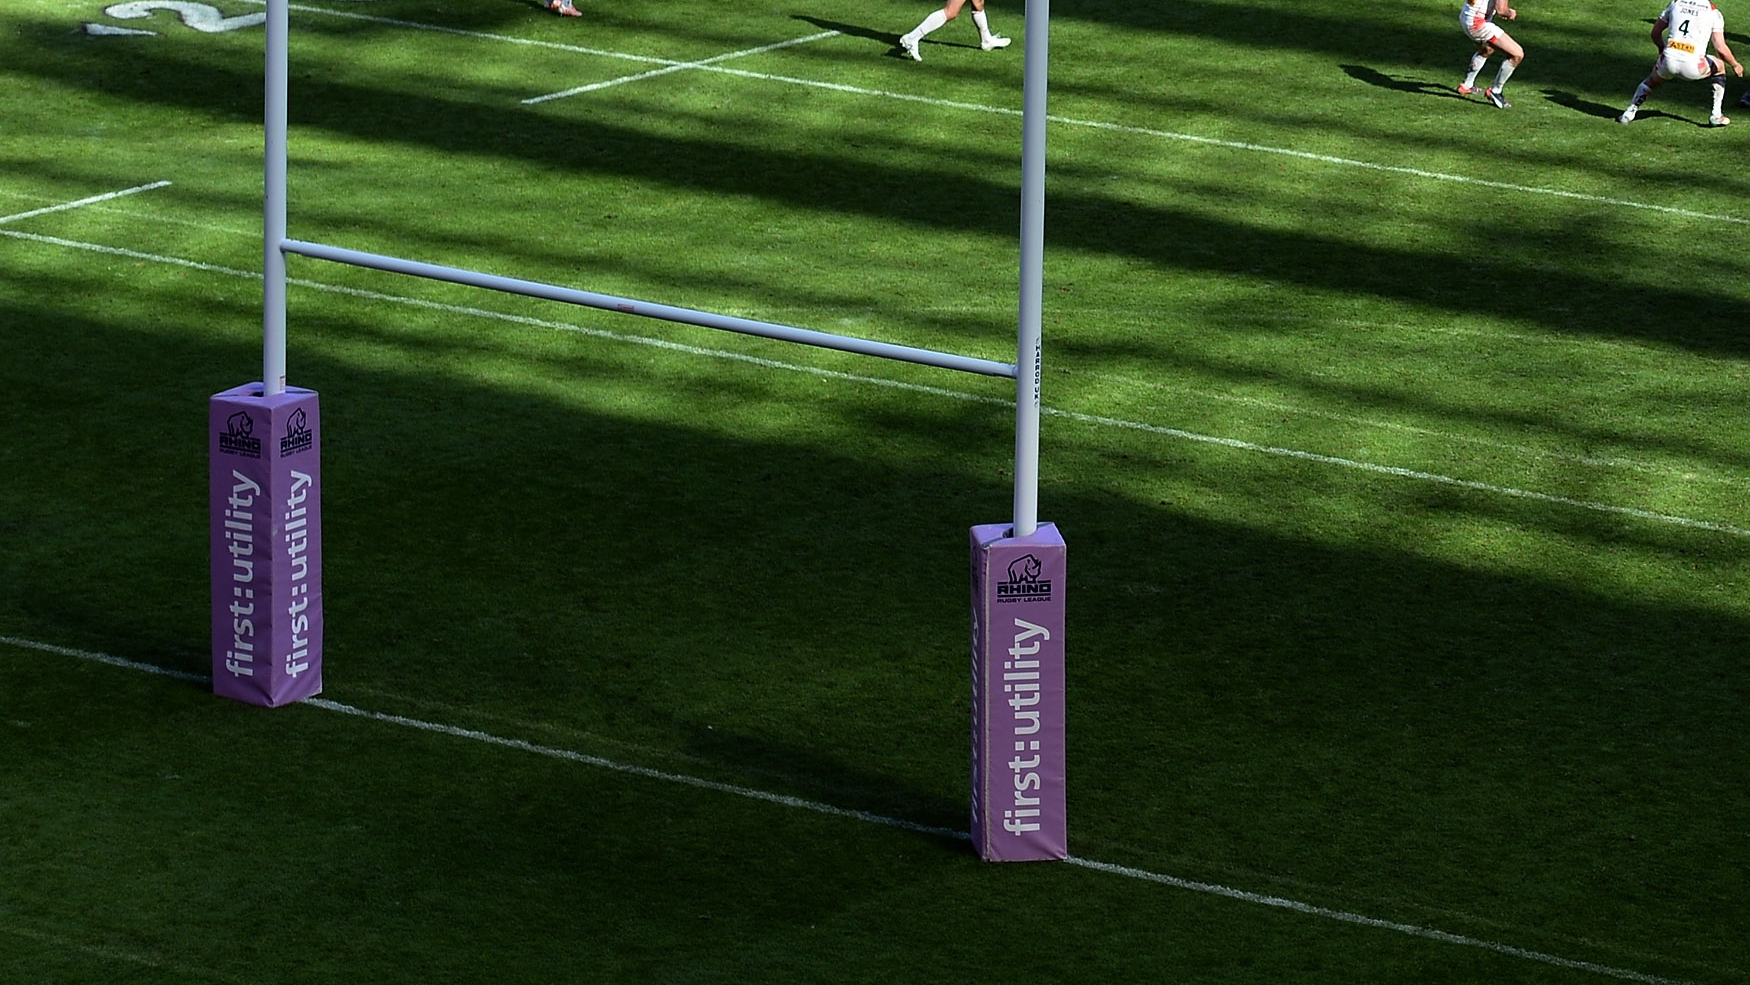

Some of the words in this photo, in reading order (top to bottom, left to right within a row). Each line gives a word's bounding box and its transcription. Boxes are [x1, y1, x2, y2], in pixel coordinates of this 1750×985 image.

[1678, 19, 1690, 37] 4
[219, 436, 261, 450] RHINO
[280, 433, 313, 450] RHINO
[225, 469, 261, 678] first:utility
[285, 470, 313, 678] first:utility
[997, 583, 1052, 595] RHINO
[1003, 618, 1050, 837] first:utility
